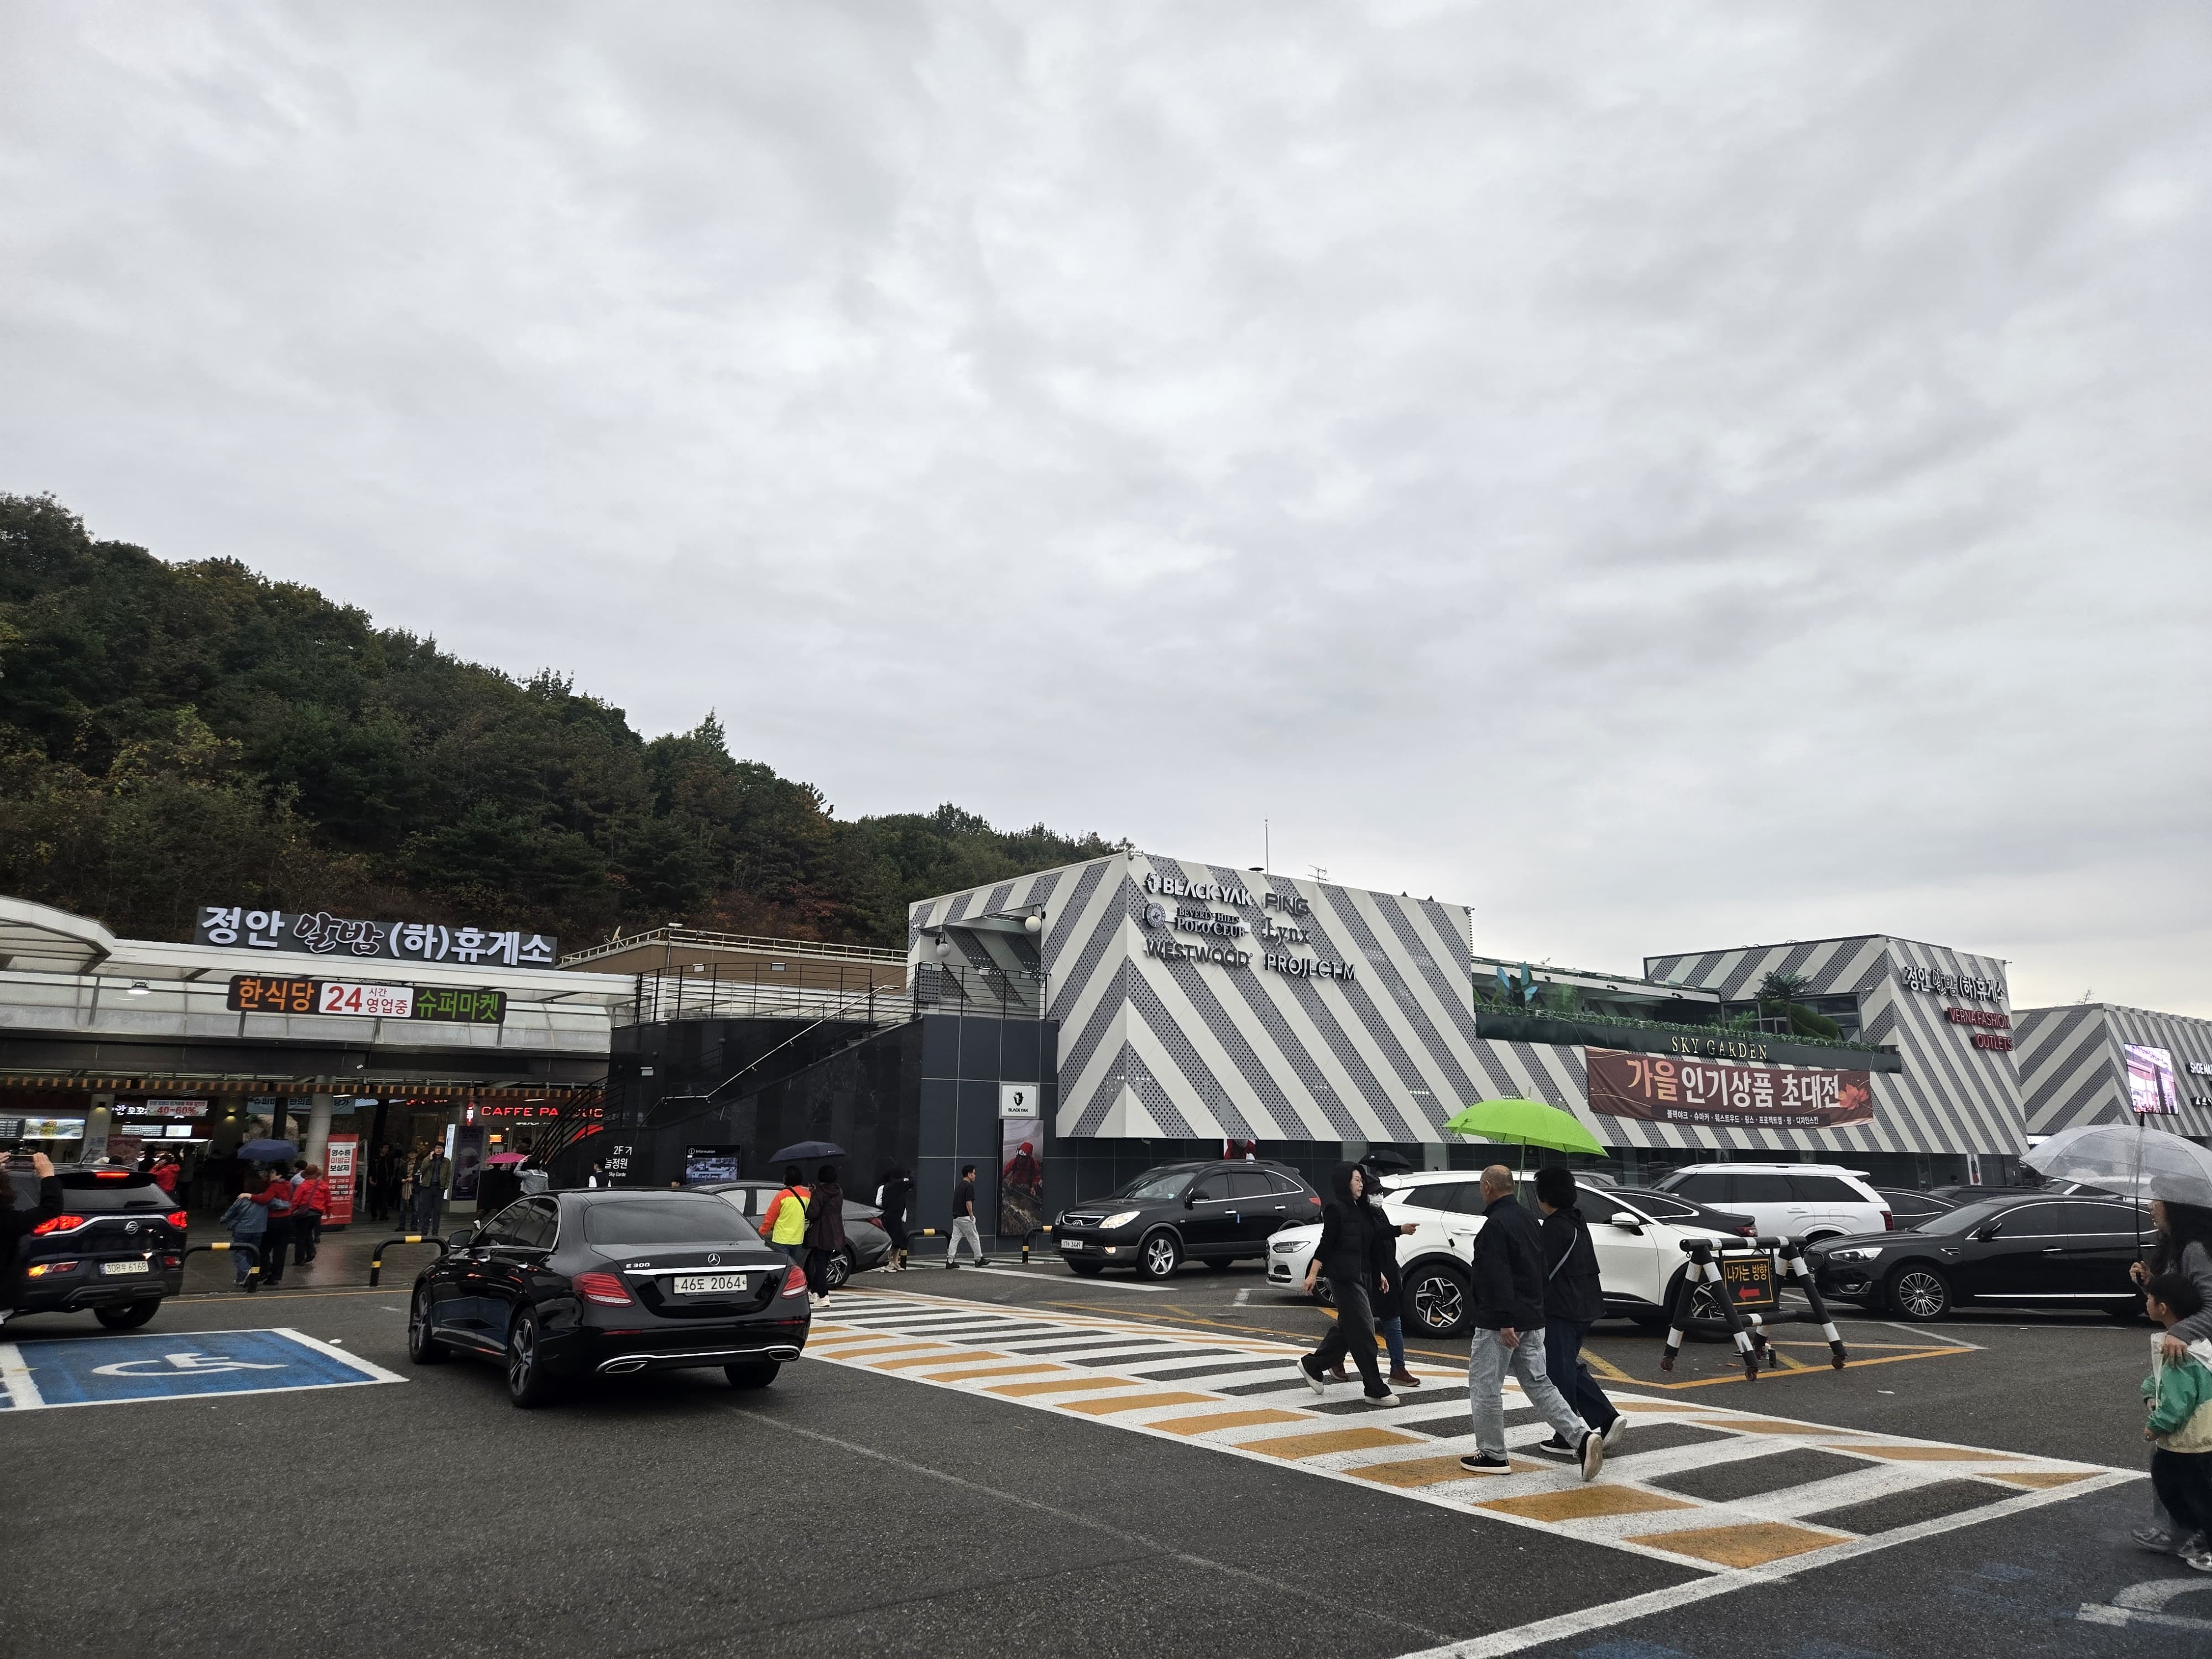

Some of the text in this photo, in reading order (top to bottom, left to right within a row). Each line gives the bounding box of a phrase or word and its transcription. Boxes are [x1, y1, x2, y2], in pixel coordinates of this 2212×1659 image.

[1264, 893, 1310, 915] PING
[1177, 907, 1214, 920] BEVERLY
[1216, 912, 1239, 924] HILLS
[202, 907, 552, 966] 정안 알밤 (하)휴게소
[1176, 917, 1245, 937] POLO CLUB
[1264, 917, 1310, 945] Lynx
[1146, 941, 1249, 967] WESTWOOD
[1266, 953, 1356, 980] PROJECT M
[239, 978, 315, 1011] 한식당
[369, 988, 387, 997] 시간
[1906, 967, 2007, 1003] 정안 알밤 (하)휴게소
[325, 986, 362, 1012] 24
[367, 998, 408, 1014] 영업중
[416, 990, 499, 1021] 슈퍼마켓
[1950, 1008, 2010, 1029] VERNA FASHION
[1672, 1036, 1767, 1059] SKY GARDEN
[1976, 1034, 2013, 1051] OUTLETS
[2190, 1062, 2204, 1074] SHOE
[1626, 1059, 1841, 1109] 가을 인기상품 초대전
[481, 1106, 533, 1117] CAFFE
[1667, 1109, 1688, 1120] 블랙야크
[1694, 1112, 1709, 1122] 슈마커
[1715, 1114, 1740, 1123] 웨스트우드
[1744, 1115, 1755, 1124] 링스
[1759, 1115, 1782, 1125] 프로젝트엠
[613, 1146, 624, 1155] 2F
[128, 1262, 147, 1271] 6168
[1727, 1264, 1767, 1282] 나가는 방향
[681, 1277, 741, 1291] 46도 2064
